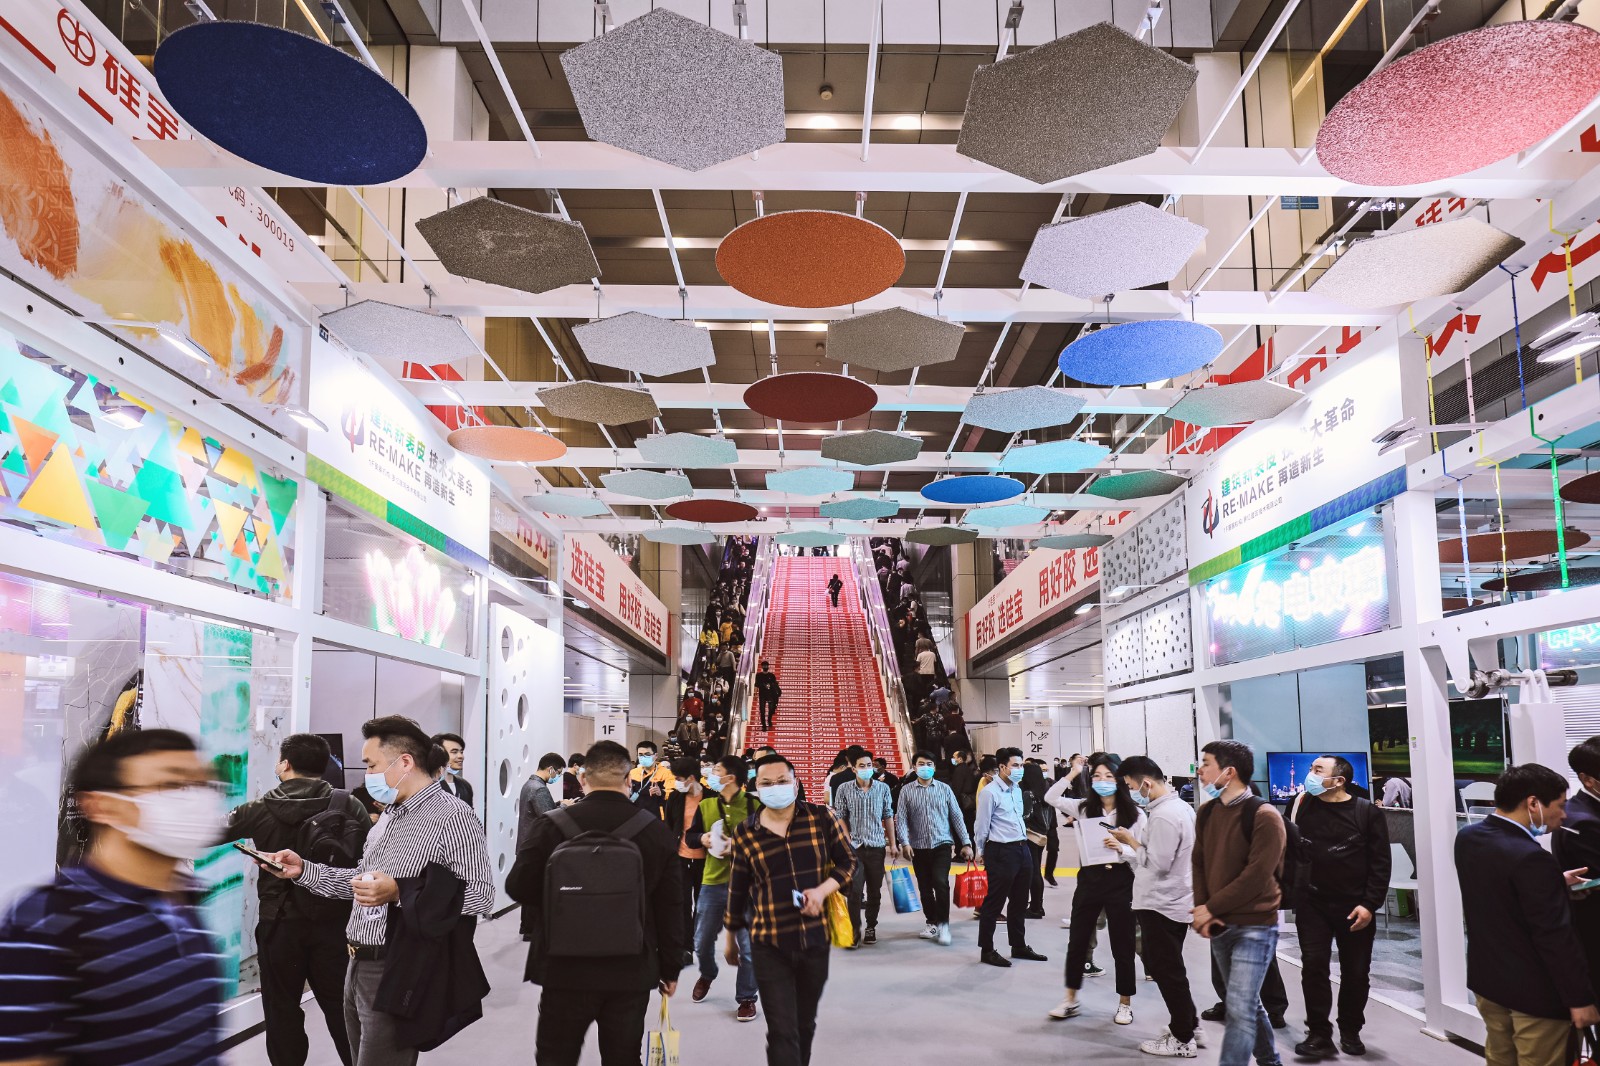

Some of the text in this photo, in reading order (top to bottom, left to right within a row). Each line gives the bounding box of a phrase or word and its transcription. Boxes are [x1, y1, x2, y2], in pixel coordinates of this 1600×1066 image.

[424, 470, 456, 506] 再造新生
[1278, 446, 1325, 487] 再造新生
[571, 537, 605, 602] 选硅宝
[1039, 549, 1077, 609] 用好胶
[618, 582, 642, 631] 用好胶
[644, 605, 662, 646] 选硅宝
[976, 611, 996, 650] 用好胶
[997, 588, 1024, 635] 选硅宝
[601, 724, 616, 735] 1F
[1030, 743, 1044, 753] 2F
